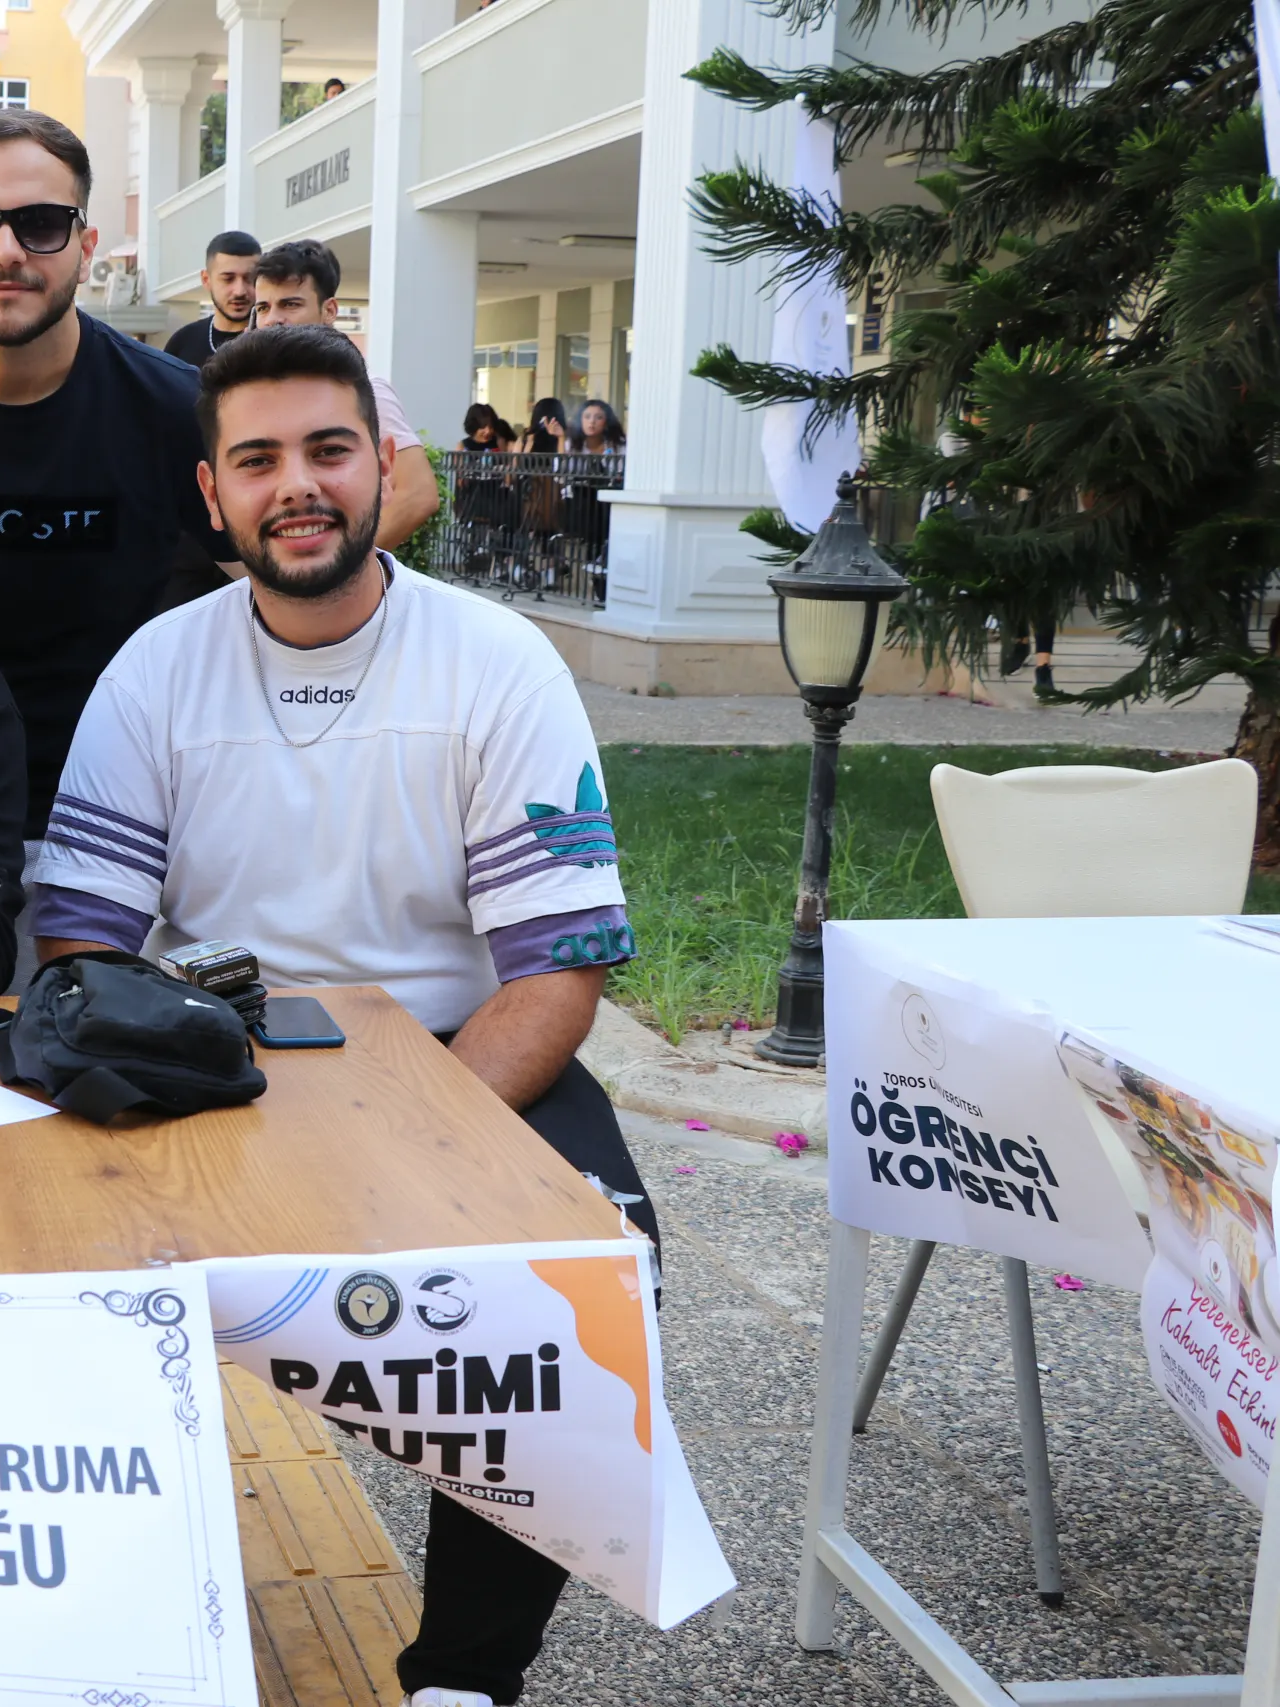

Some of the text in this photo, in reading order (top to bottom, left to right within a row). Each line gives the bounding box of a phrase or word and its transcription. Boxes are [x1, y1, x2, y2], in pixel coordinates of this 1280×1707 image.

[280, 685, 356, 704] adidas
[883, 1072, 926, 1088] TOROS
[1161, 1299, 1221, 1383] Kahvaltı
